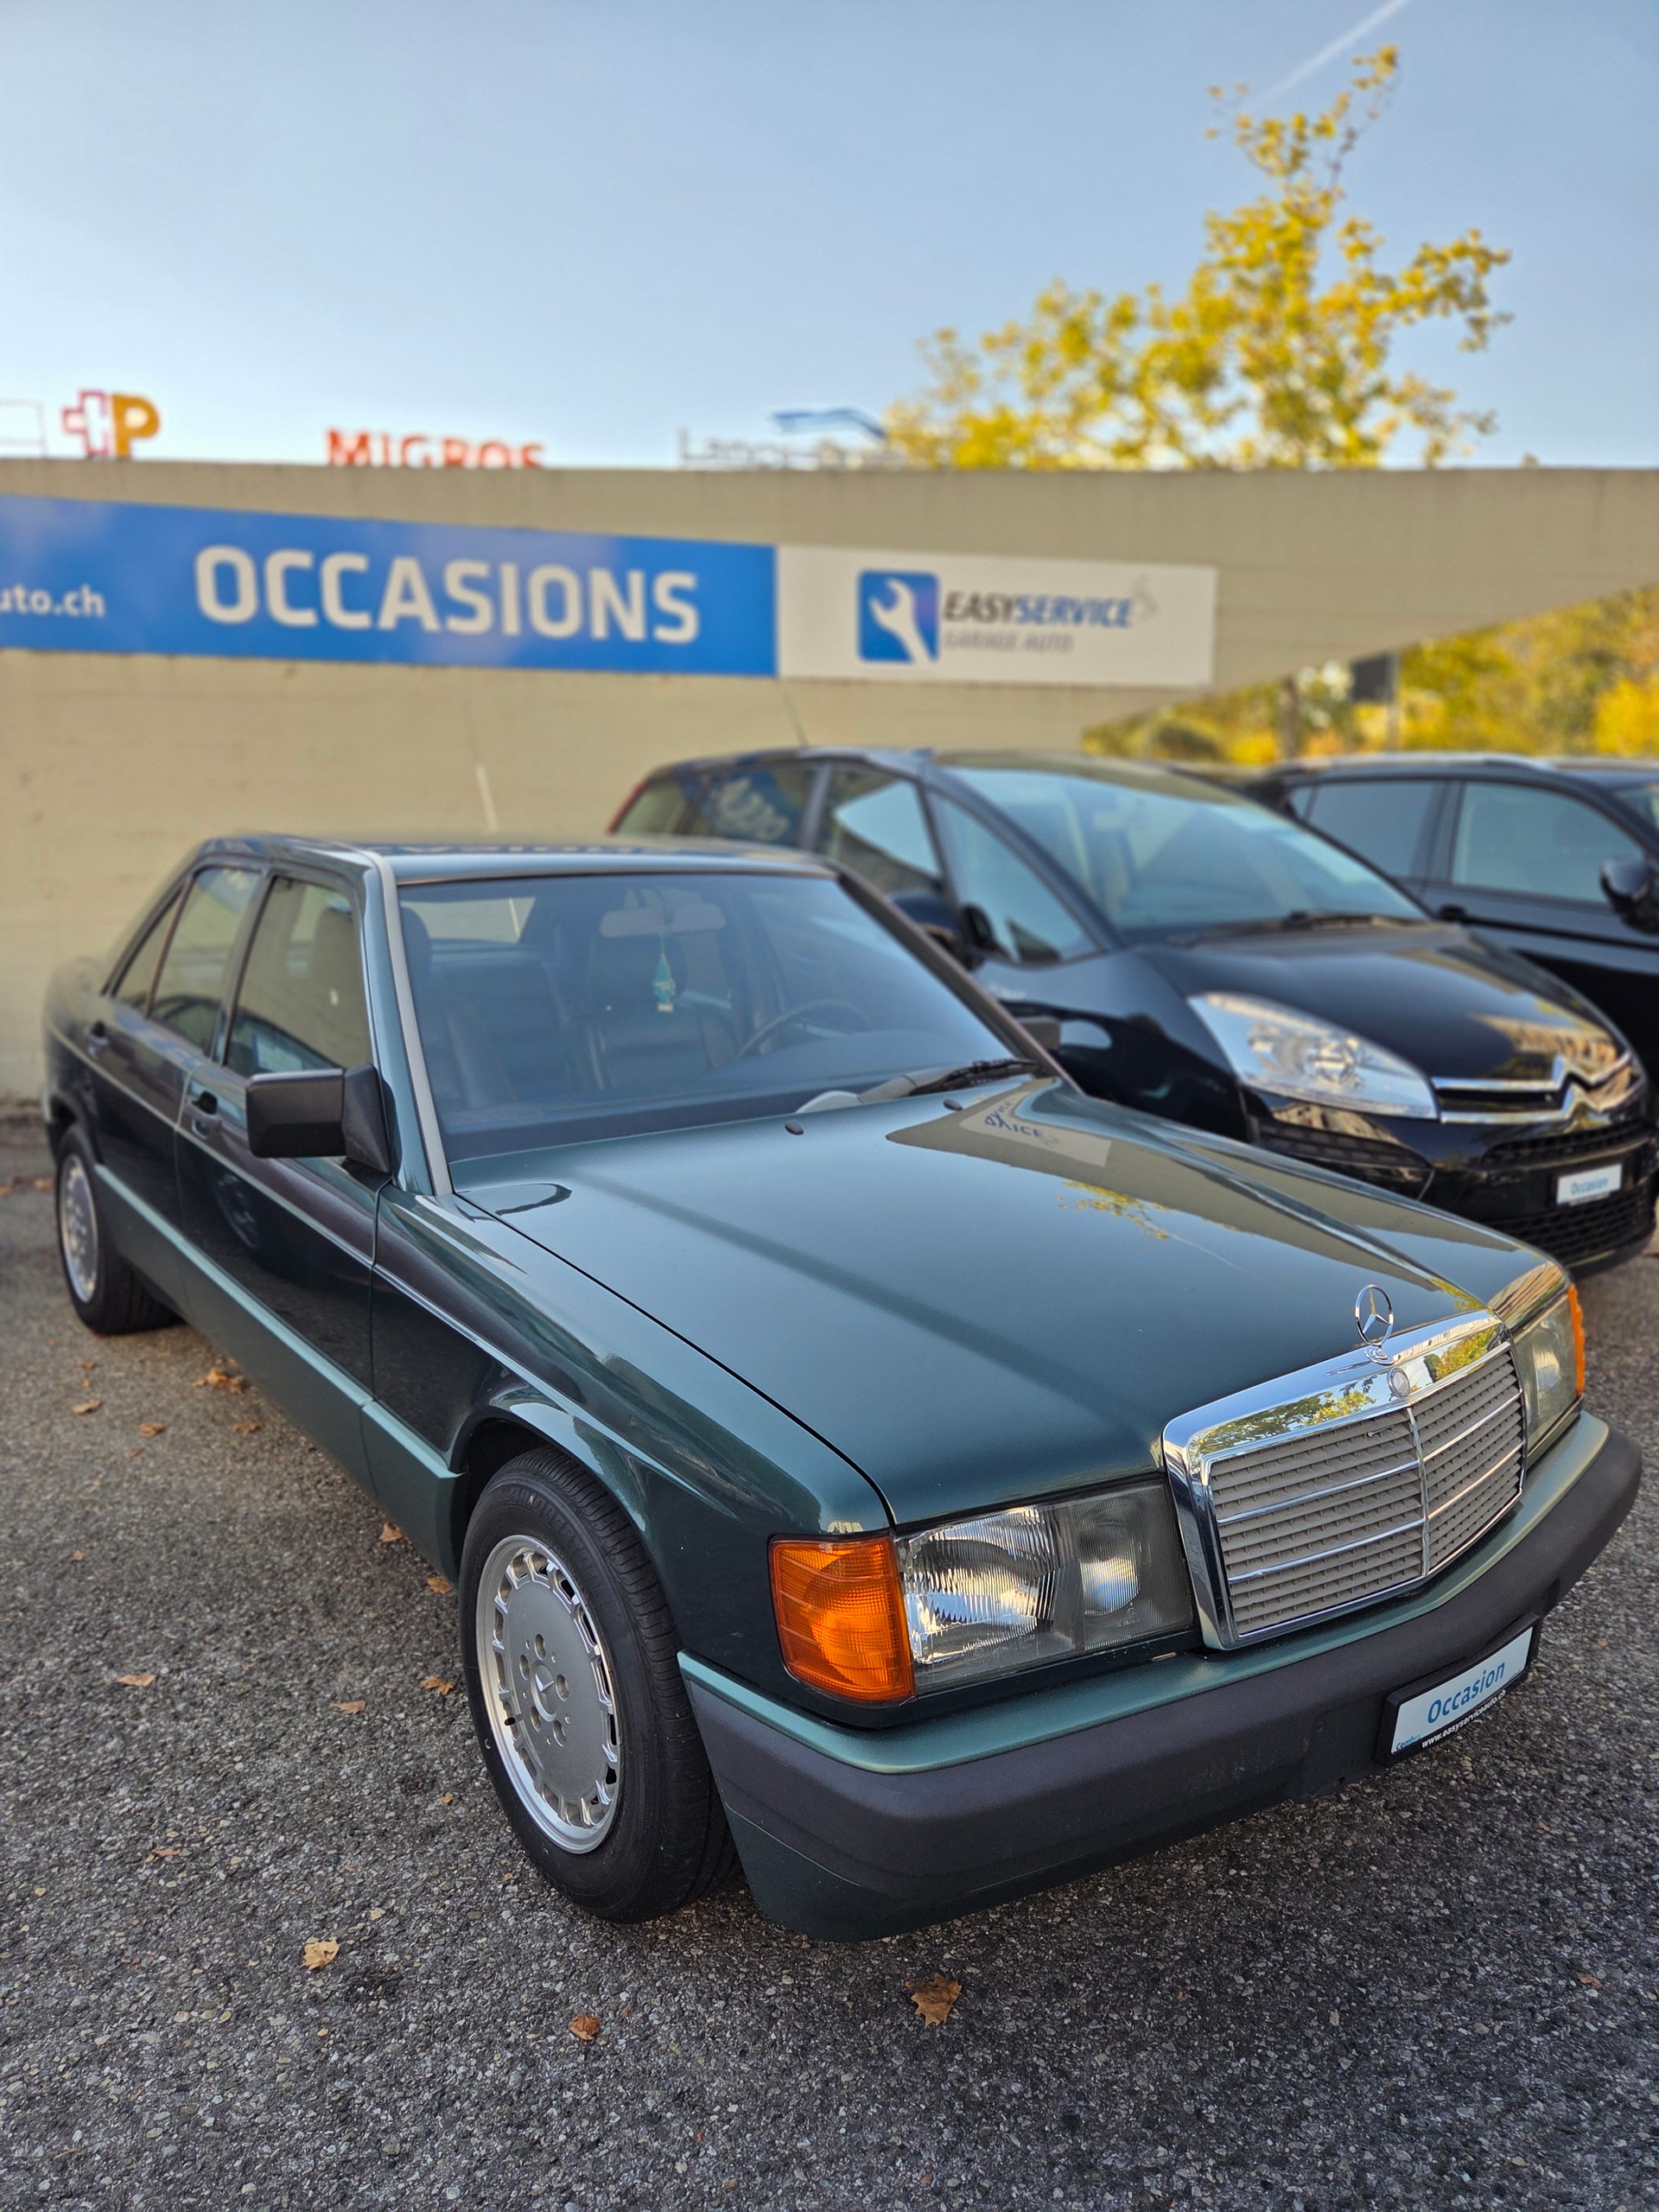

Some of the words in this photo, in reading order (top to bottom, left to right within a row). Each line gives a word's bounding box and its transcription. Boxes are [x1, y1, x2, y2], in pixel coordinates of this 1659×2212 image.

[327, 429, 543, 467] MIGROS
[195, 545, 700, 643] OCCASIONS
[1421, 1689, 1506, 1748] www.easyserviceauto.ch
[1427, 1662, 1505, 1724] Occasion
